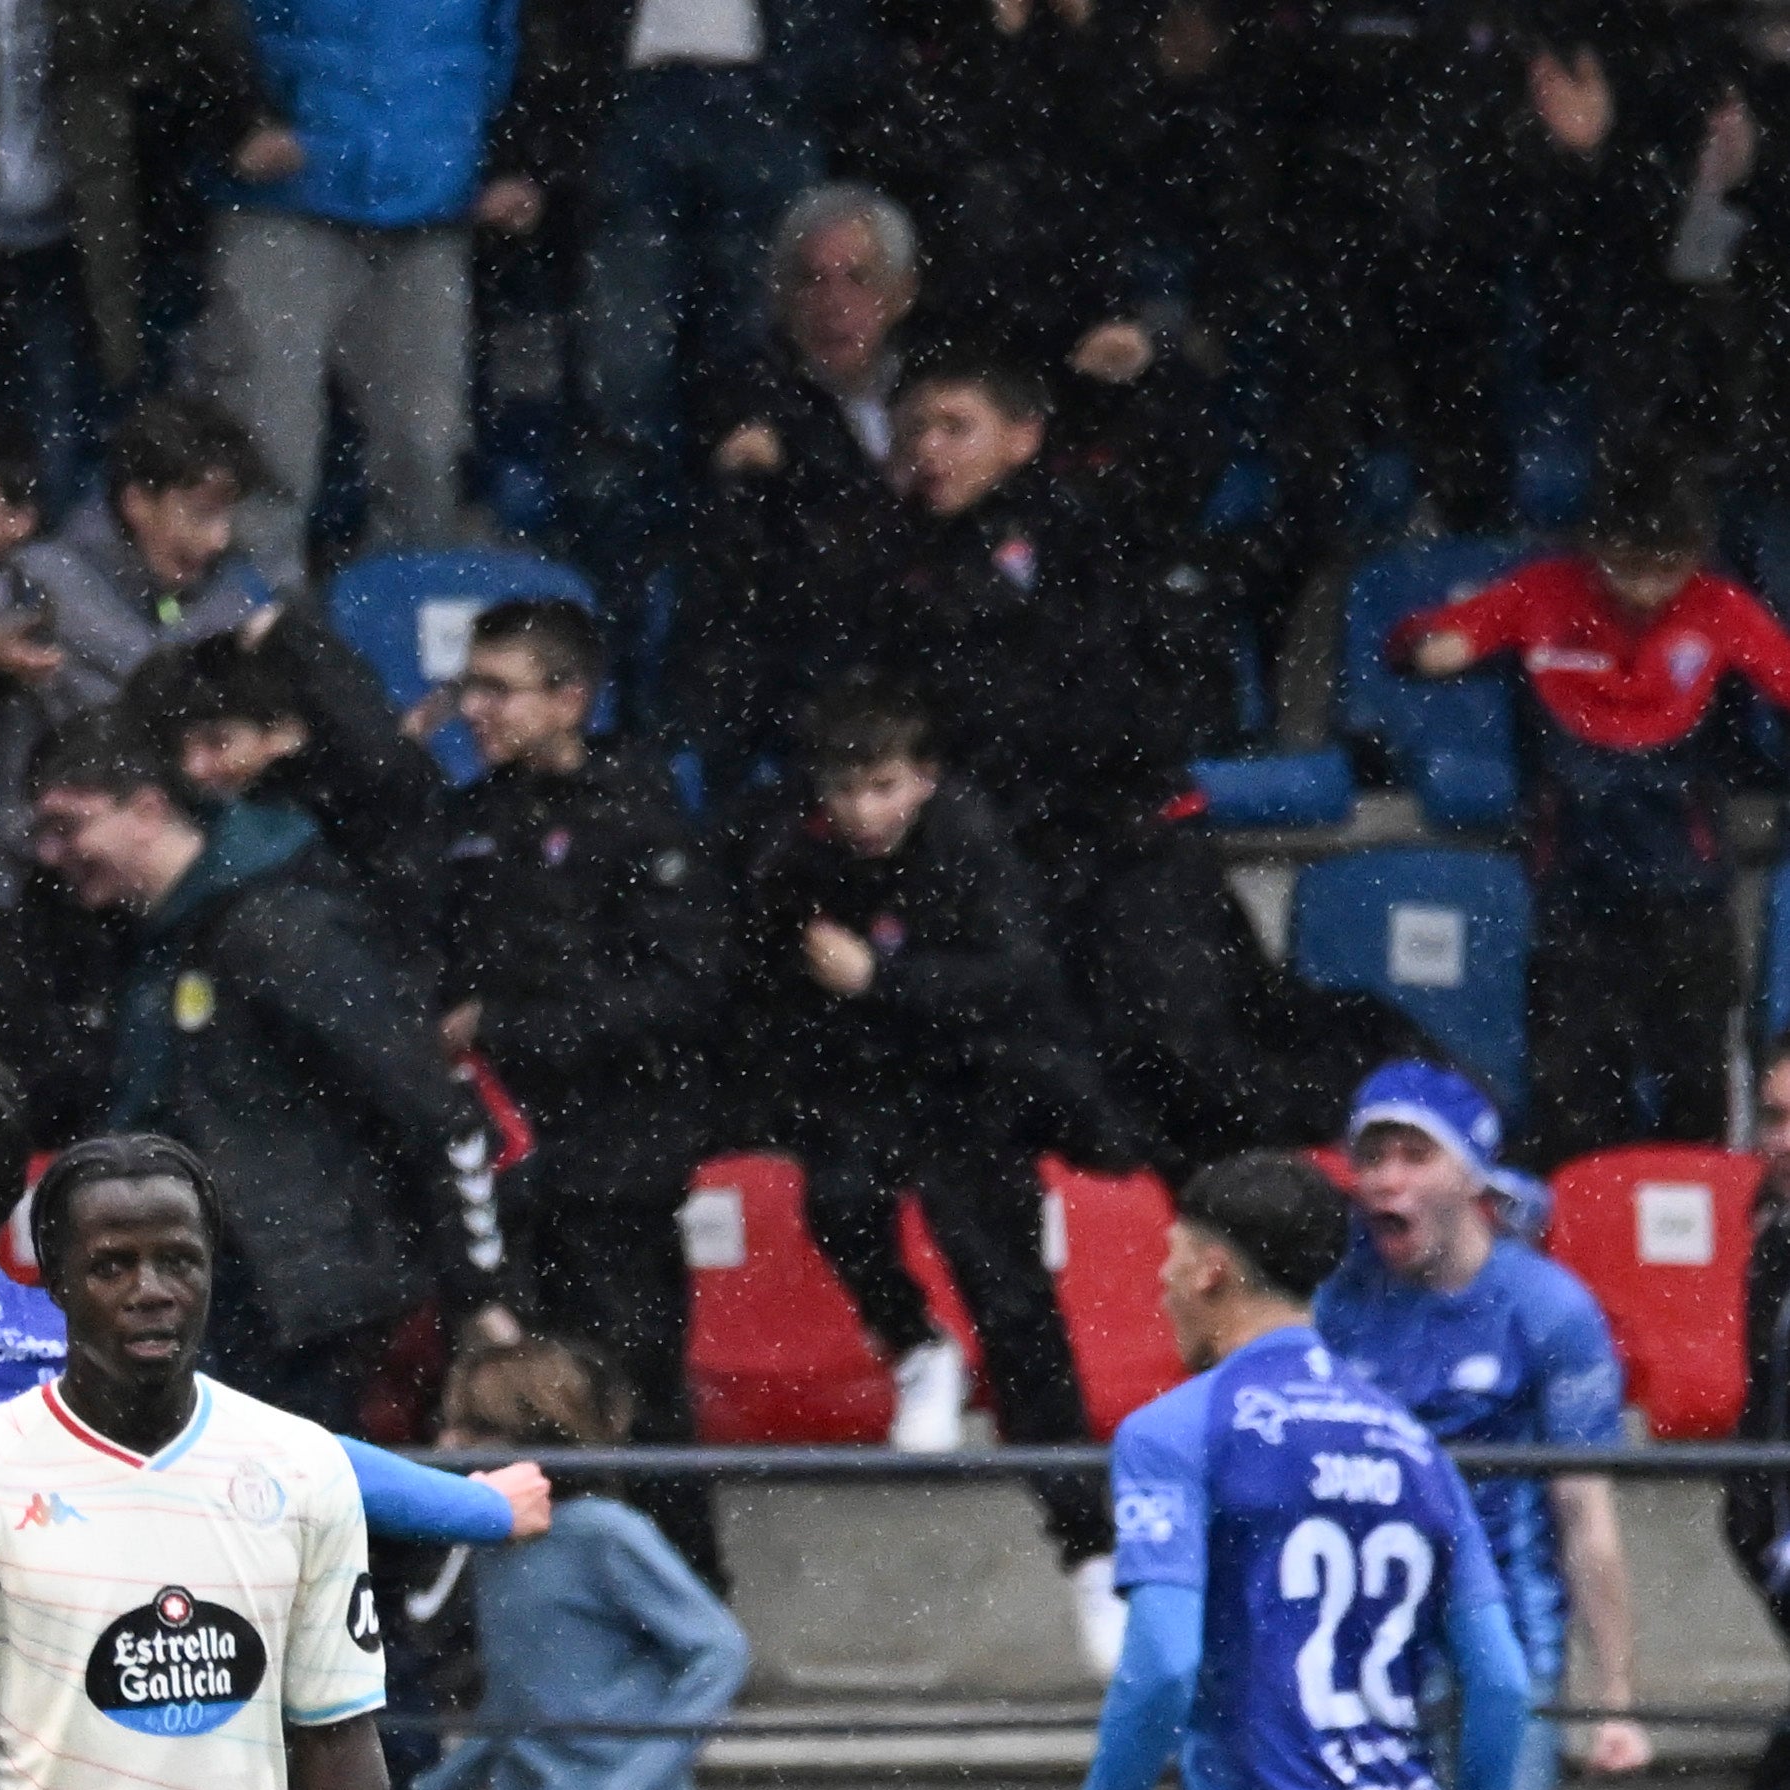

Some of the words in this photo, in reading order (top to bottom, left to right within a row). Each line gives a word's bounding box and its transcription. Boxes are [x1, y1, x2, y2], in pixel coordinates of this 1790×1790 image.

[1280, 1518, 1433, 1731] 22
[114, 1626, 237, 1666] Estrella
[120, 1661, 233, 1702] Galicia
